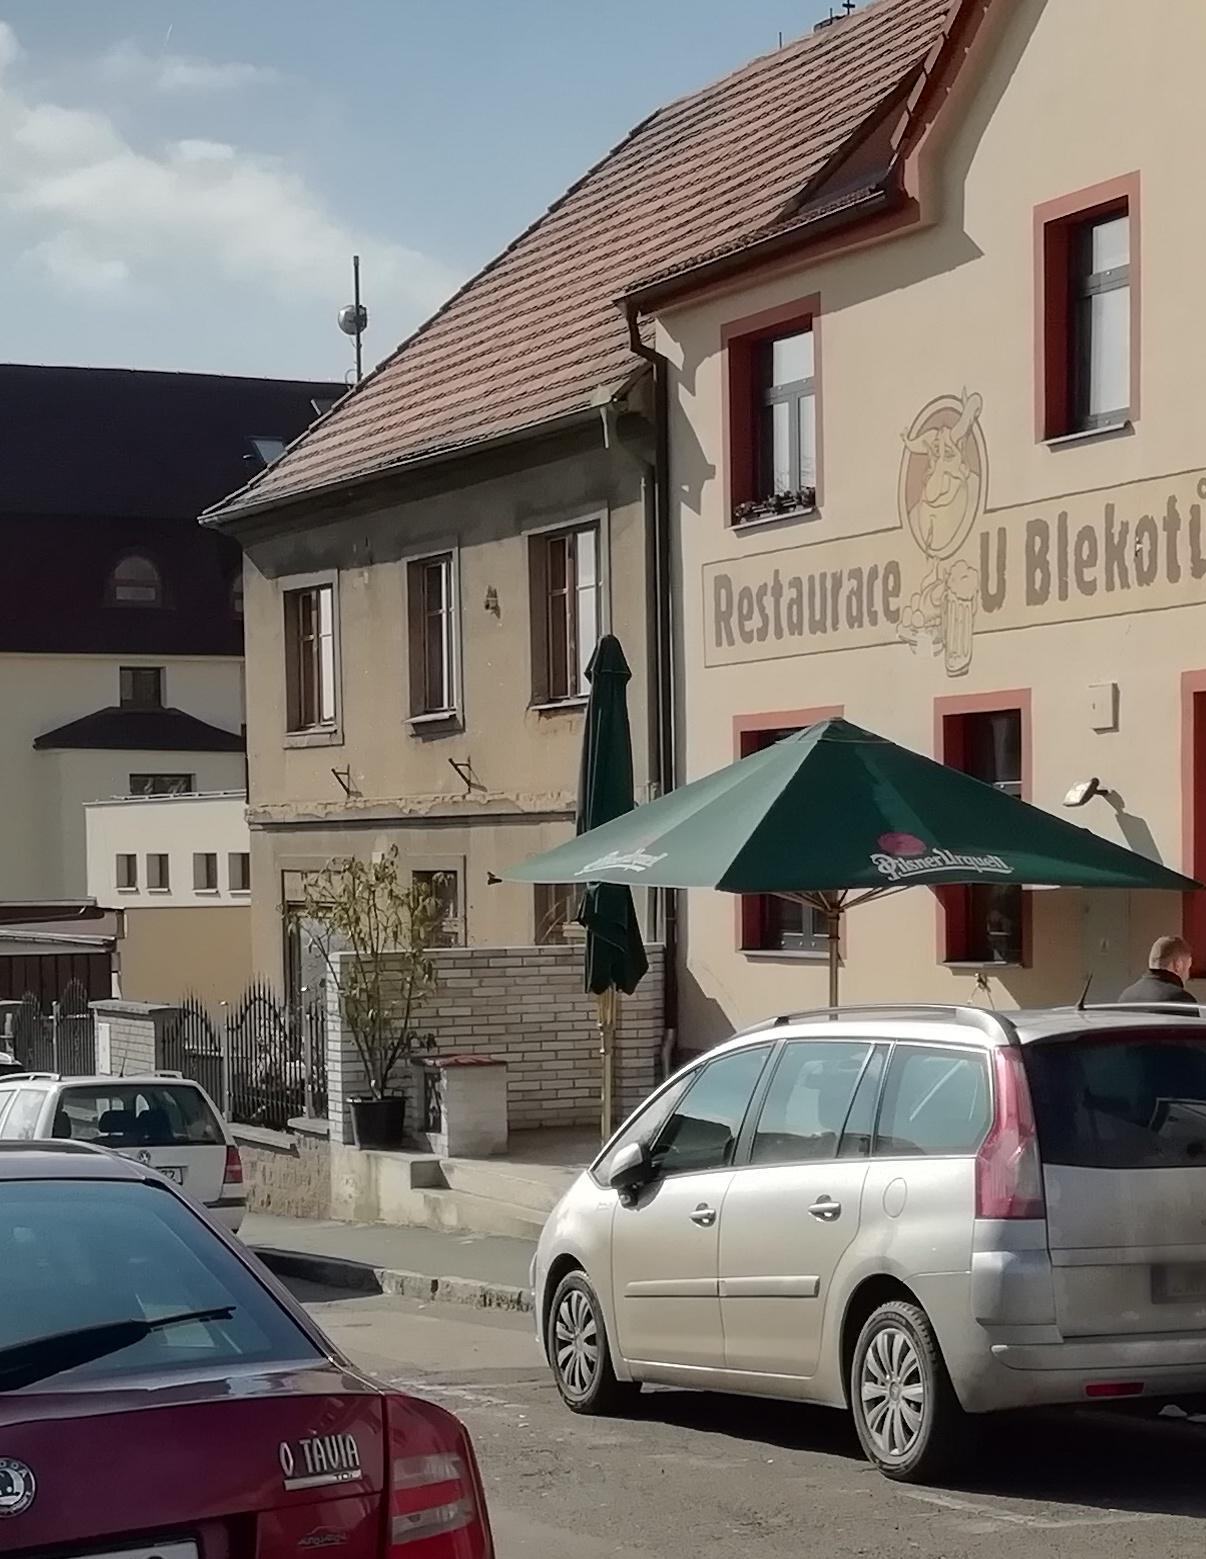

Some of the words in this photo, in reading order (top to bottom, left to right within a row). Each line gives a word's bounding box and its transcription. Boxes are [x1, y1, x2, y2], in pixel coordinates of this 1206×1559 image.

[713, 560, 901, 648] Restaurace
[979, 526, 1007, 614] U
[870, 853, 942, 881] Pilsner
[932, 848, 1010, 873] Urquell
